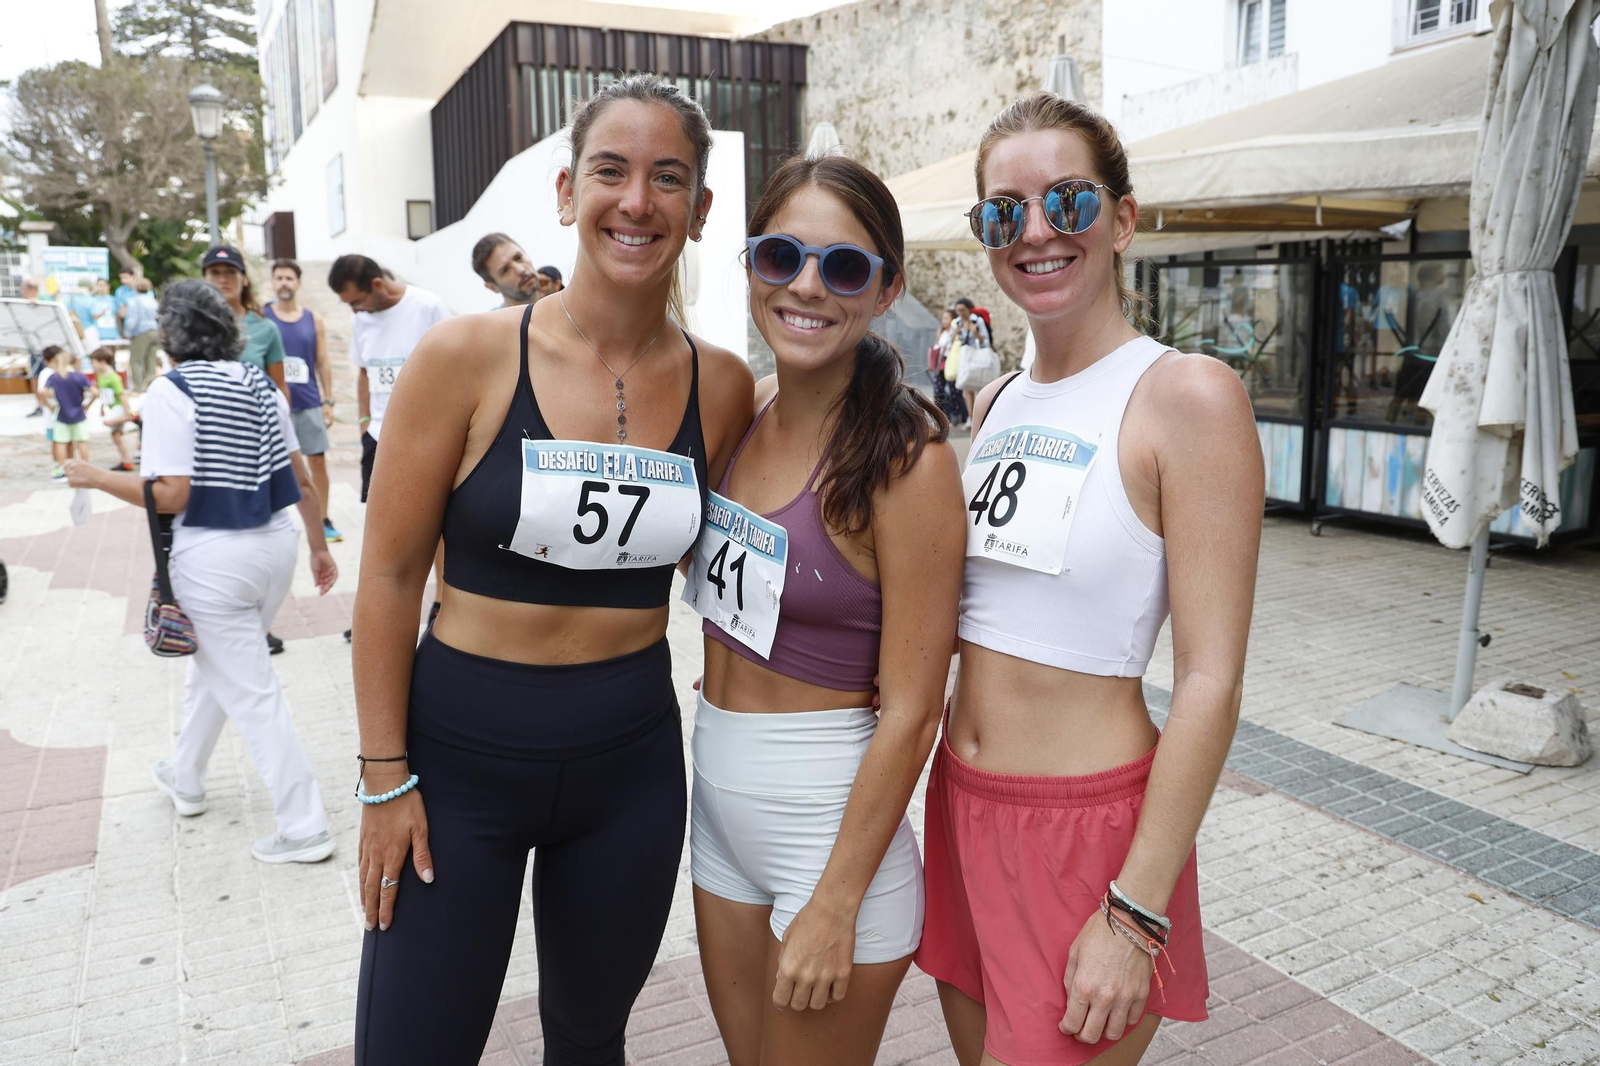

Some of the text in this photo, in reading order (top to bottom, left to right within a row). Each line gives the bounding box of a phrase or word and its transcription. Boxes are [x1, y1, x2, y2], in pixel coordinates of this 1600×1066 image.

[538, 449, 684, 483] DESAFÍO ELA TARIFA
[1000, 430, 1030, 459] ELA
[1027, 434, 1078, 462] TARIFA
[969, 461, 1026, 527] 48
[1425, 468, 1461, 513] CERVEZAS
[573, 480, 650, 547] 57
[728, 511, 750, 547] ELA
[748, 524, 776, 557] TARIFA
[995, 540, 1028, 556] TARIFA
[707, 540, 747, 612] 41
[737, 621, 756, 639] TARIFA
